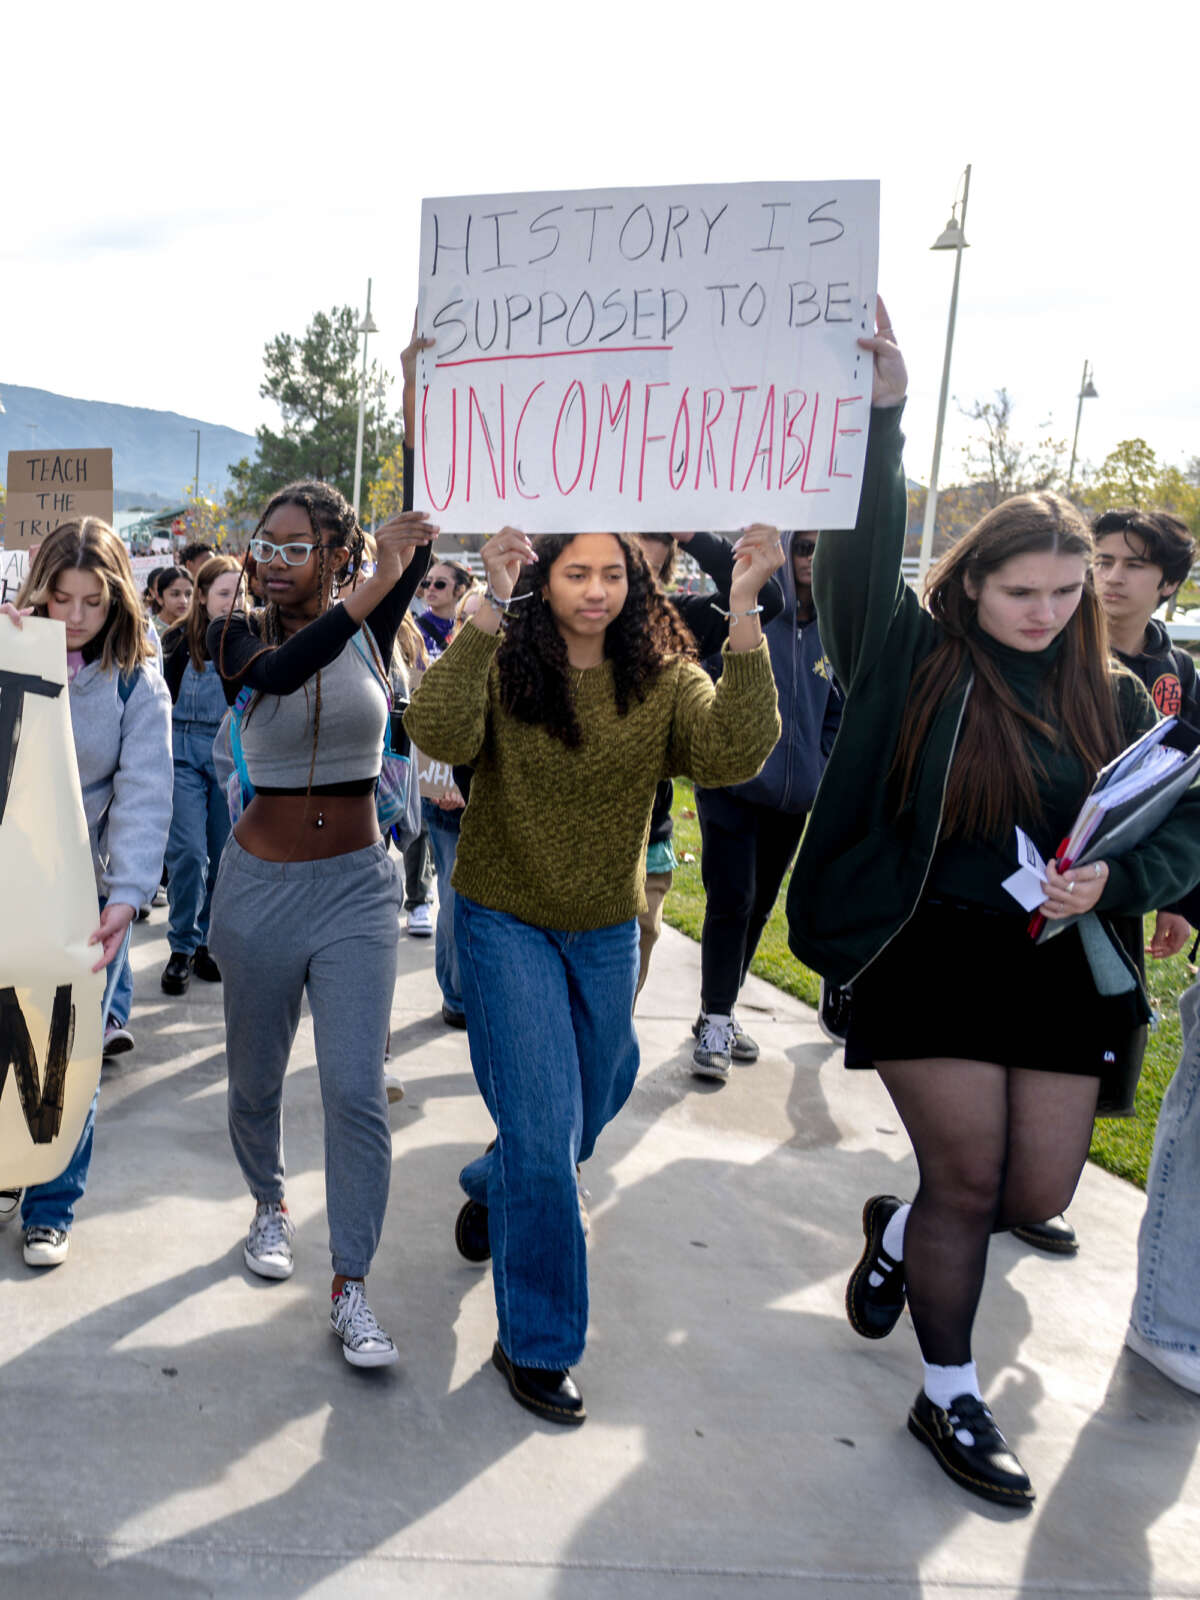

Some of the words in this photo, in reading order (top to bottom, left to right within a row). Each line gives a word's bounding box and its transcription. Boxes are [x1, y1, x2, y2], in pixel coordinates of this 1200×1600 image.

[431, 203, 729, 276] HISTORY
[751, 199, 846, 251] IS
[432, 288, 688, 359] SUPPOSED
[705, 281, 767, 327] TO
[788, 281, 854, 328] BE
[26, 456, 88, 484] TEACH
[421, 378, 864, 512] UNCOMFORTABLE
[13, 518, 60, 537] TRU
[36, 492, 73, 512] THE
